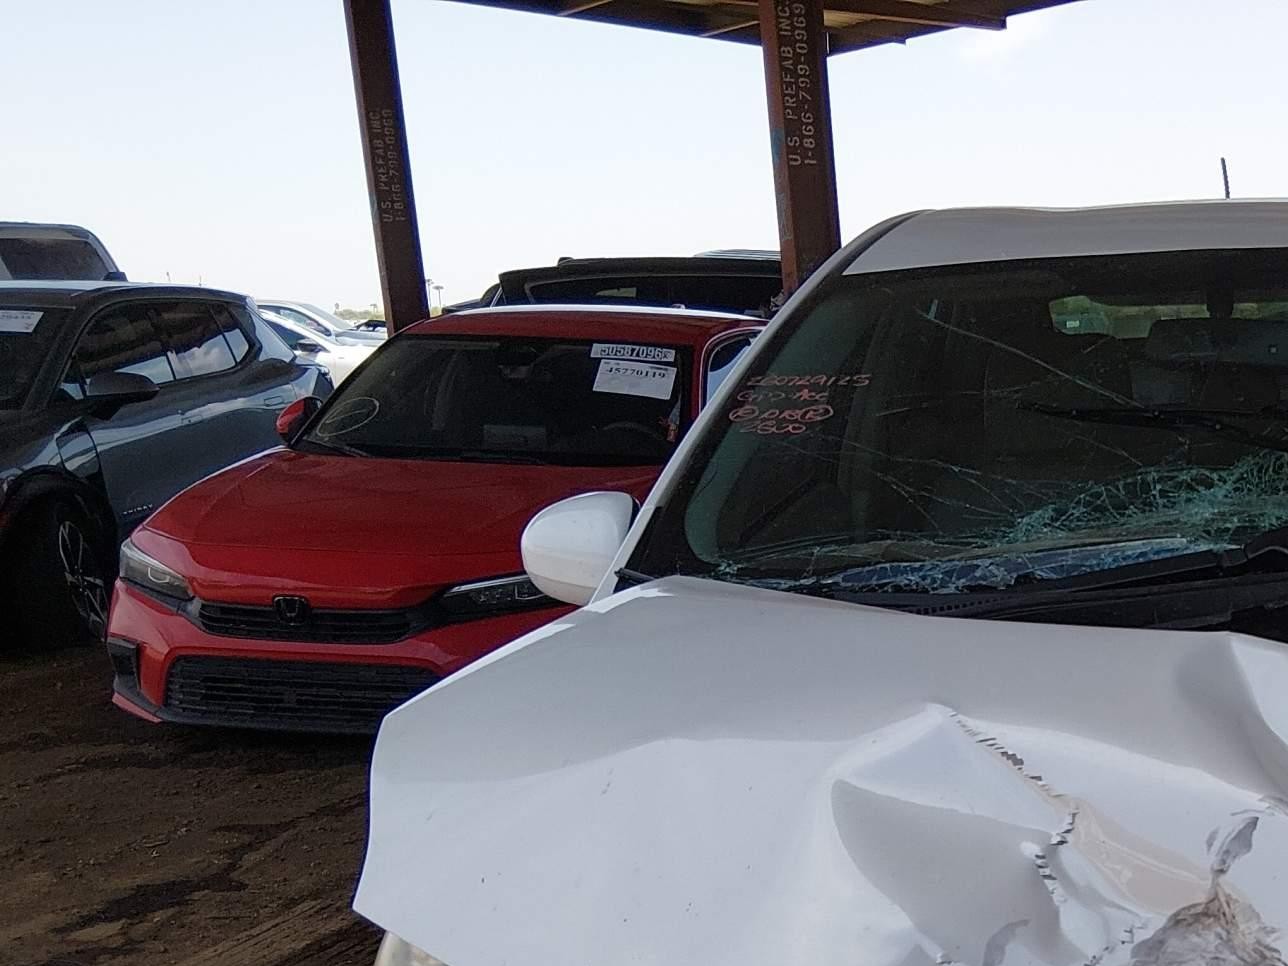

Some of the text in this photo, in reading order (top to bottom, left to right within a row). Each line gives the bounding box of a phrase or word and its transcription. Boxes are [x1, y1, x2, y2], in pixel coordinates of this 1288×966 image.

[781, 46, 798, 119] PREFAB
[793, 3, 817, 165] 1-866-799-0969
[373, 140, 391, 190] PREFAB
[600, 345, 662, 360] 50587096
